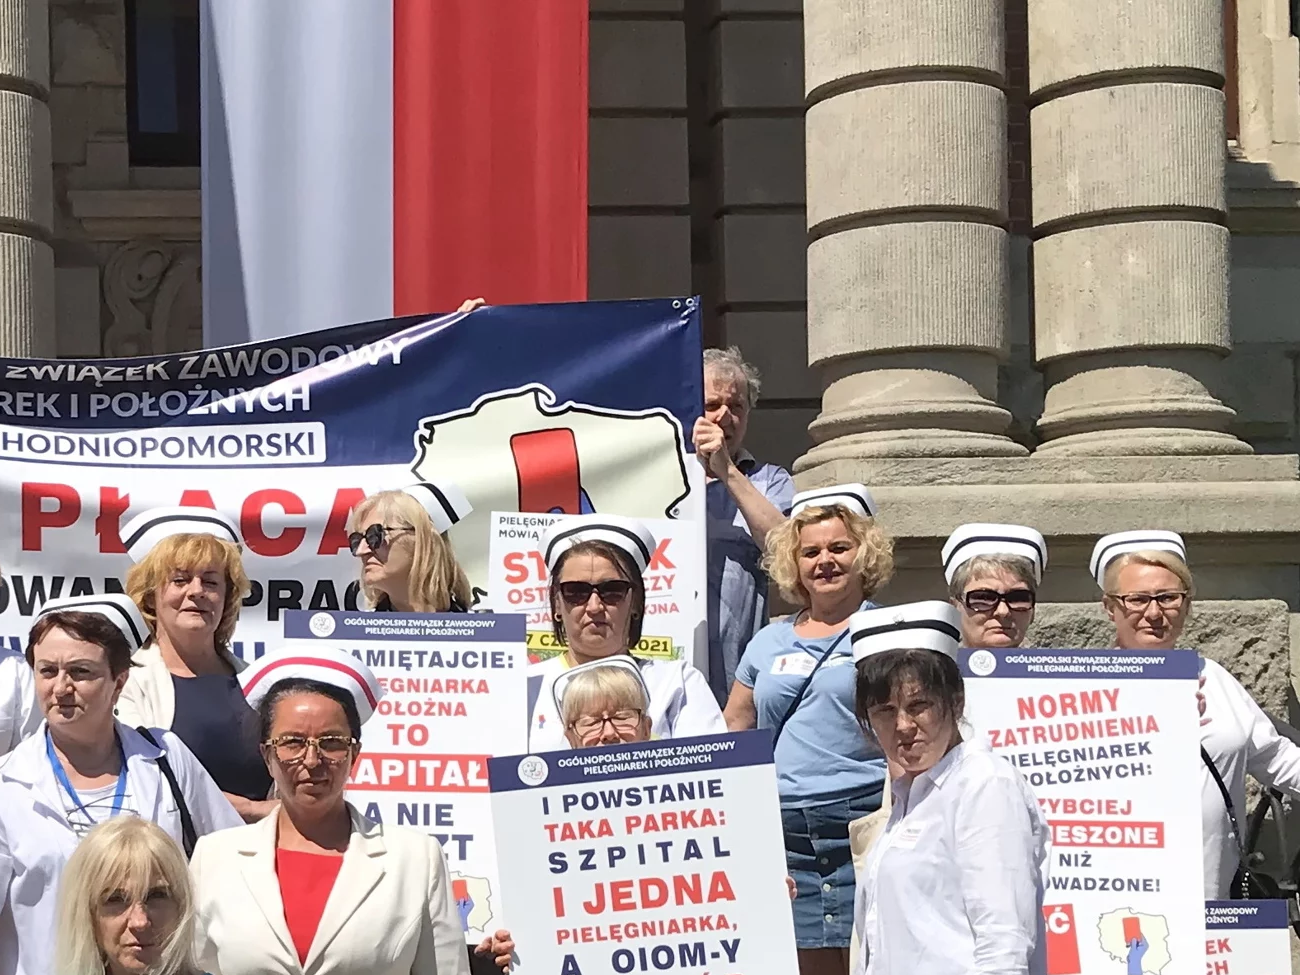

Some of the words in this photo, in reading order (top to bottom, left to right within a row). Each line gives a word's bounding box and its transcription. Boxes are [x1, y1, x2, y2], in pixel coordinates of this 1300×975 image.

[4, 360, 170, 387] ZWIĄZEK
[177, 337, 409, 380] ZAWODOWY
[70, 393, 78, 418] I
[89, 378, 312, 418] POŁOŻNYCH
[344, 617, 407, 626] OGÓLNOPOLSKI
[408, 619, 444, 628] ZWIĄZEK
[445, 619, 495, 628] ZAWODOWY
[365, 628, 420, 636] PIELĘGNIAREK
[426, 627, 474, 636] POŁOŻNYCH
[342, 650, 514, 672] AMIĘTAJCIE:
[1005, 655, 1071, 664] OGÓLNOPOLSKI
[1072, 656, 1111, 665] ZWIĄZEK
[1112, 657, 1165, 665] ZAWODOWY
[1028, 665, 1085, 673] PIELĘGNIAREK
[1091, 664, 1143, 673] POŁOŻNYCH
[1017, 688, 1120, 721] NORMY
[387, 724, 429, 746] TO
[988, 715, 1160, 748] ZATRUDNIENIA
[558, 753, 631, 768] OGÓLNOPOLSKI
[633, 747, 675, 761] ZWIĄZEK
[676, 741, 736, 755] ZAWODOWY
[584, 762, 648, 775] PIELĘGNIAREK
[655, 754, 712, 768] POŁOŻNYCH
[347, 758, 488, 787] APITAŁ
[542, 797, 549, 815] I
[563, 779, 724, 813] POWSTANIE
[364, 802, 383, 824] A
[397, 803, 454, 826] NIE
[544, 818, 614, 843] TAKA
[625, 808, 726, 835] PARKA:
[549, 837, 730, 874] SZPITAL
[1059, 851, 1092, 868] NIŻ
[553, 887, 565, 917] I
[583, 871, 736, 915] JEDNA
[1210, 907, 1258, 915] ZAWODOWY
[557, 914, 738, 945] PIELĘGNIARKA,
[612, 939, 741, 975] OIOM-Y
